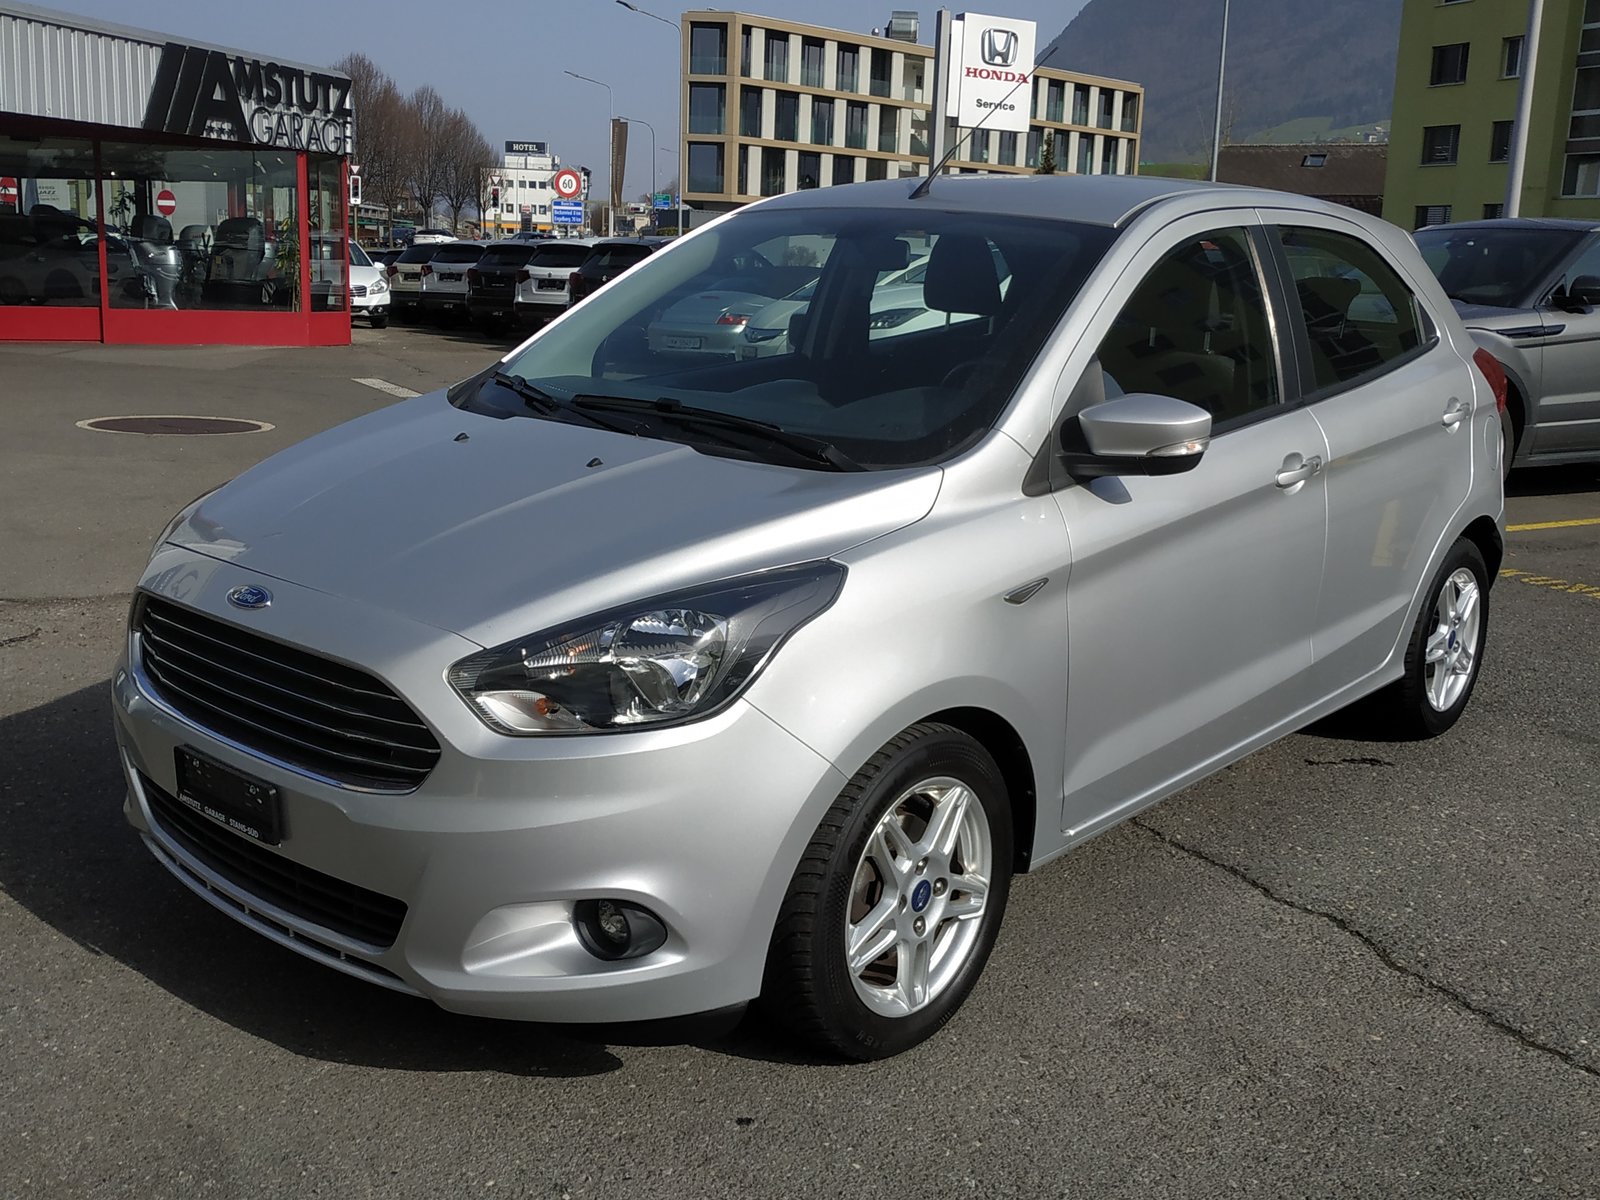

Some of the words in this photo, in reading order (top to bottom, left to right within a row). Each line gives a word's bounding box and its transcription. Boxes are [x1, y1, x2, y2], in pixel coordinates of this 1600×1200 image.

[965, 67, 1029, 84] HONDA
[185, 48, 352, 142] AMSTUTZ
[976, 98, 1015, 111] Service
[251, 107, 352, 154] GARAGE
[512, 143, 539, 151] HOTEL
[562, 178, 573, 189] 60
[204, 806, 226, 823] GARAGE
